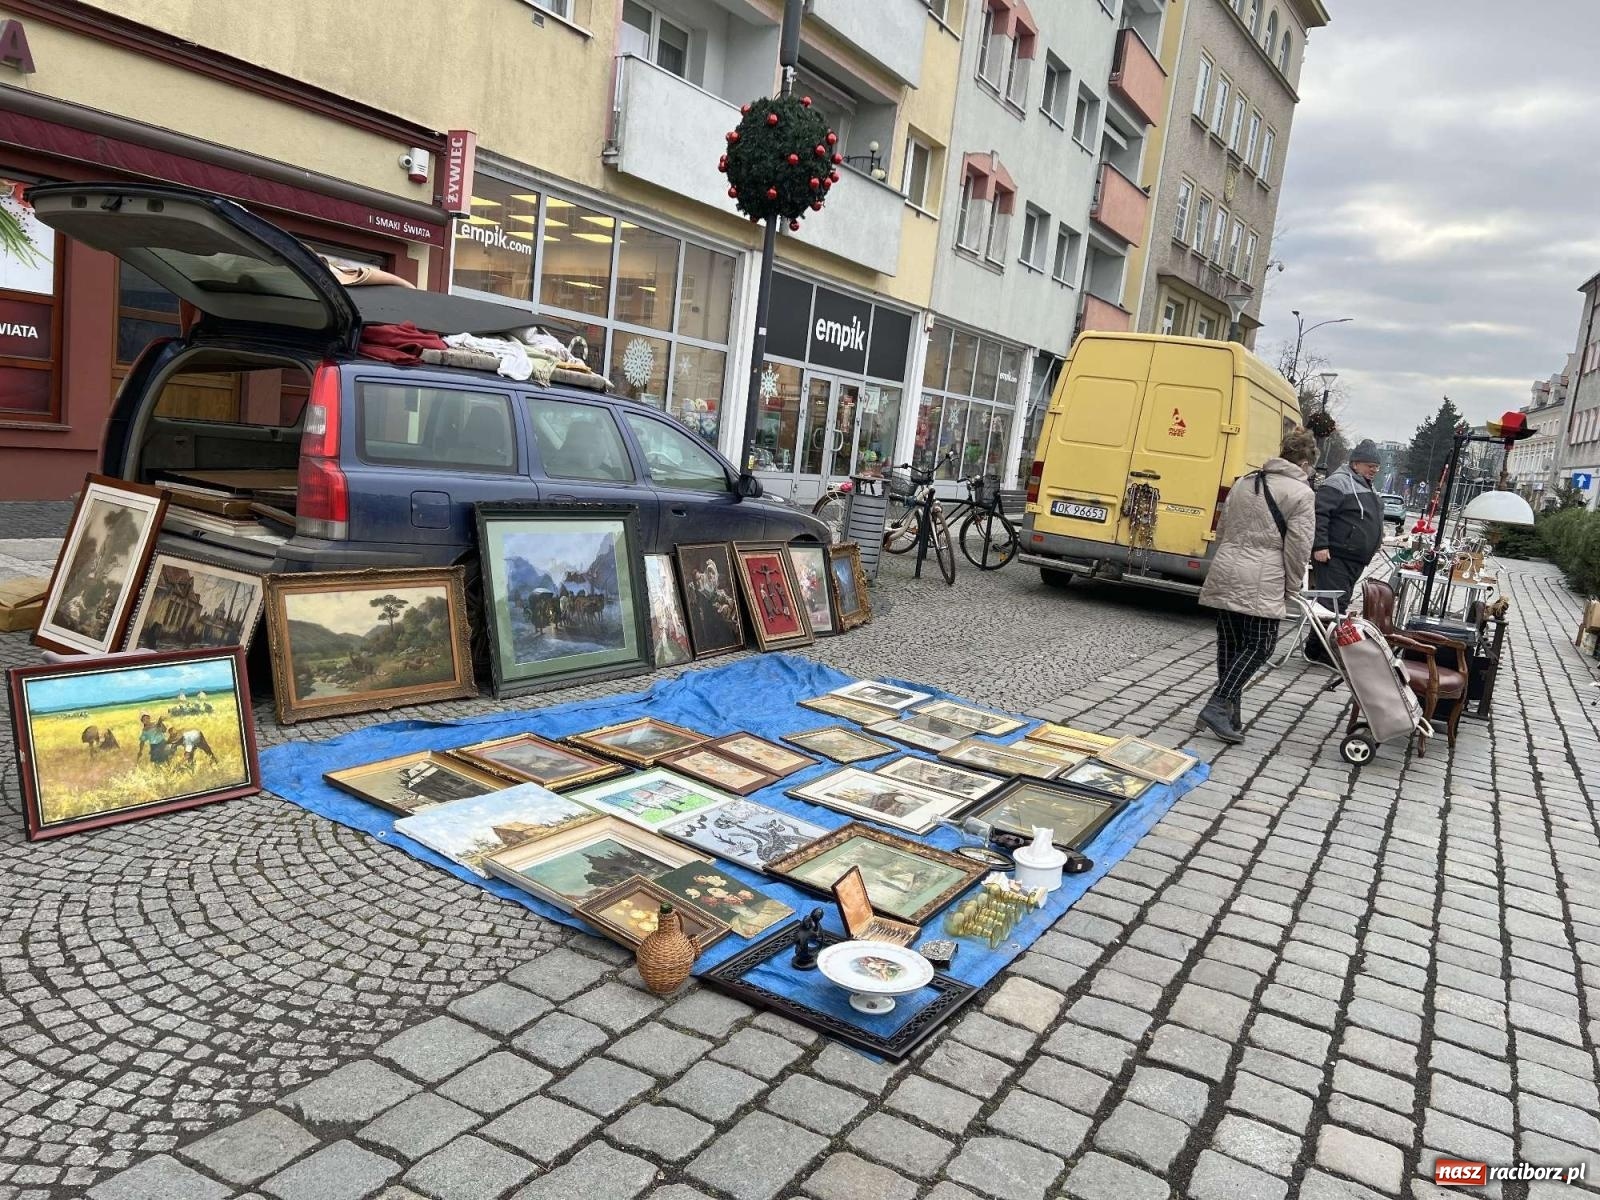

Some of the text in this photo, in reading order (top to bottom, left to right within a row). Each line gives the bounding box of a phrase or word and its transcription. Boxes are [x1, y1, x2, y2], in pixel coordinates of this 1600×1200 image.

[447, 137, 464, 204] ŻYWIEC
[375, 216, 401, 231] SMAKI
[403, 222, 431, 238] ŚWIATA
[461, 223, 532, 255] empik.com
[815, 315, 866, 352] empik
[1058, 503, 1104, 519] OK 96653
